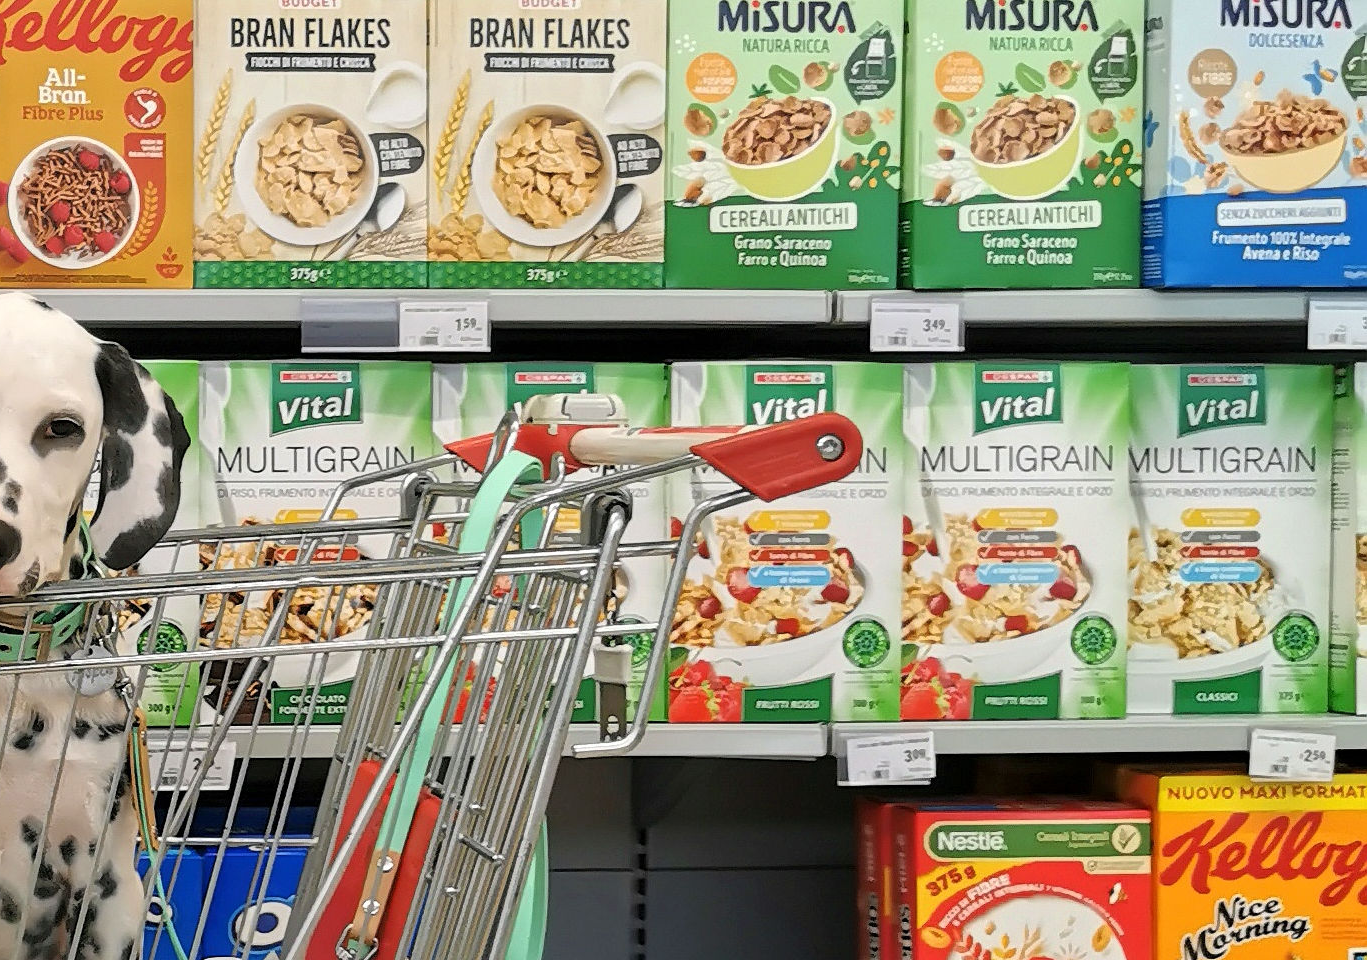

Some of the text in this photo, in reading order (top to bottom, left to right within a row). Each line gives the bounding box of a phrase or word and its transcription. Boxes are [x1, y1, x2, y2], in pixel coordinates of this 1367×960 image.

[230, 17, 391, 49] BRAN FLAKES
[469, 17, 631, 49] BRAN FLAKES
[1248, 32, 1325, 48] DOLCESENZA
[742, 38, 831, 54] NATURA RICCA
[989, 36, 1074, 52] NATURA RICCA
[45, 67, 86, 88] All-
[38, 86, 89, 105] Bran
[22, 105, 104, 121] Fibre Plus
[719, 205, 850, 229] CEREALI ANTICHI
[967, 205, 1094, 227] CEREALI ANTICHI
[1219, 208, 1251, 221] SENZA
[734, 234, 832, 251] Grano Saraceno
[983, 233, 1078, 249] Grano Saraceno
[1211, 230, 1269, 245] Frumento
[1298, 231, 1352, 249] Integrale
[738, 250, 827, 268] Farro e Quinoa
[986, 248, 1073, 266] Farro e Quinoa
[1242, 246, 1320, 261] Avena e Riso
[278, 387, 354, 425] Vital
[752, 388, 827, 426] Vital
[980, 387, 1056, 425] Vital
[1185, 389, 1259, 427] Vital
[218, 446, 414, 474] MULTIGRAIN
[921, 445, 1114, 472] MULTIGRAIN
[1128, 446, 1317, 473] MULTIGRAIN
[1167, 786, 1234, 800] NUOVO
[1239, 785, 1286, 800] MAXI
[925, 867, 963, 897] 375
[1212, 896, 1282, 932] Nice
